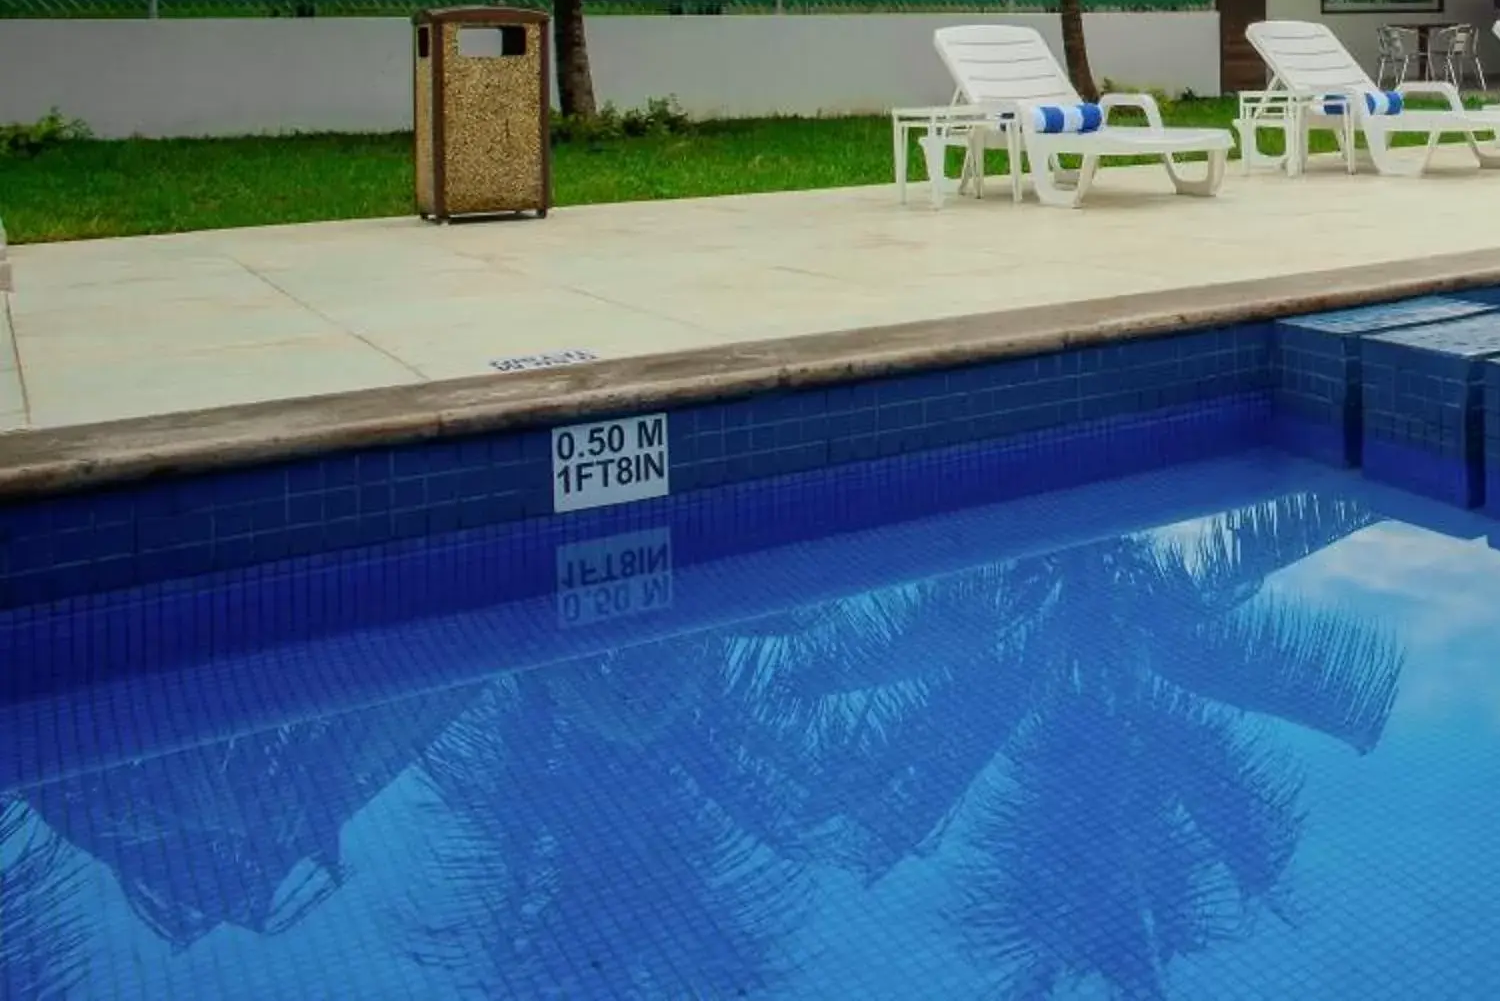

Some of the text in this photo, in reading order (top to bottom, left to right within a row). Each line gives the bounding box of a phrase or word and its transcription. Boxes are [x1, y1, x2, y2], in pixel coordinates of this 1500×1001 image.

[558, 418, 664, 461] 0.50 M
[557, 450, 666, 494] 1FT8IN
